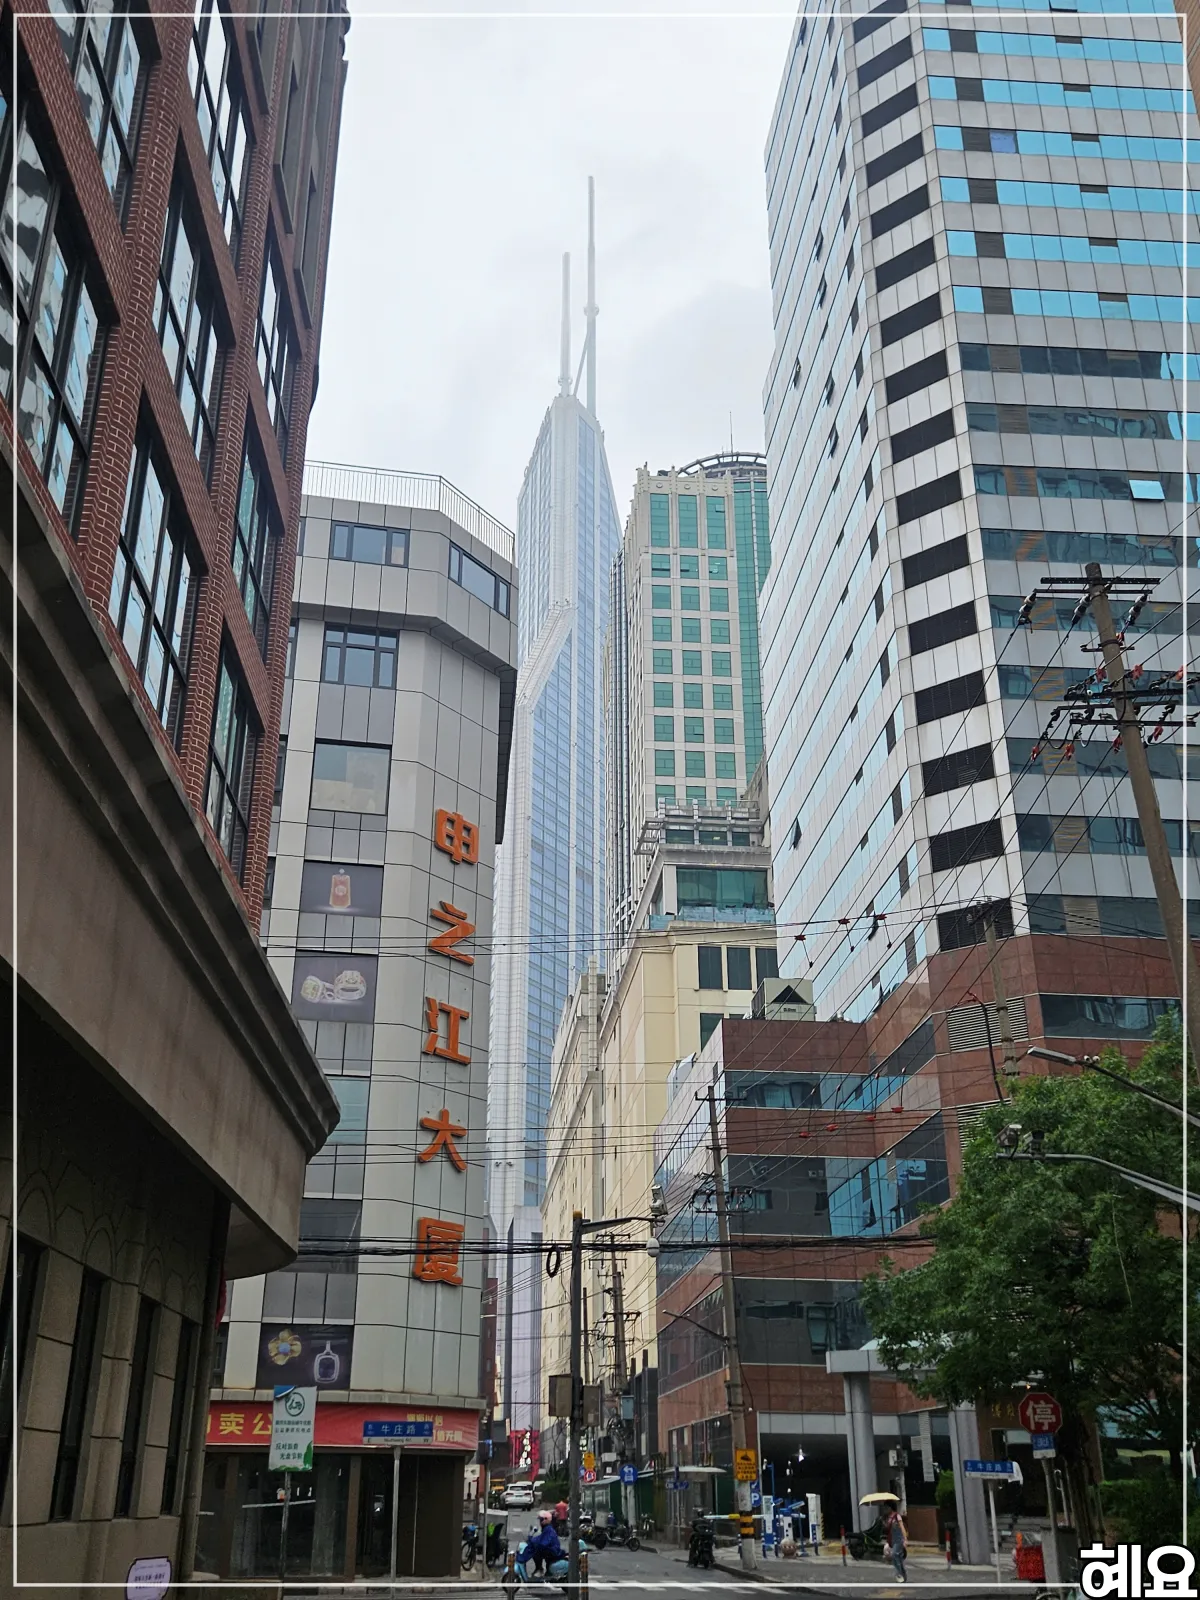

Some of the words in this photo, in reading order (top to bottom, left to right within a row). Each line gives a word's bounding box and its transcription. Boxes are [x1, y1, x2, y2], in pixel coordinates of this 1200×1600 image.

[413, 808, 479, 1286] 申之江大厦
[207, 1412, 273, 1435] 卖公
[1026, 1400, 1057, 1430] 停
[381, 1424, 416, 1435] 牛庄路
[751, 1492, 760, 1505] P
